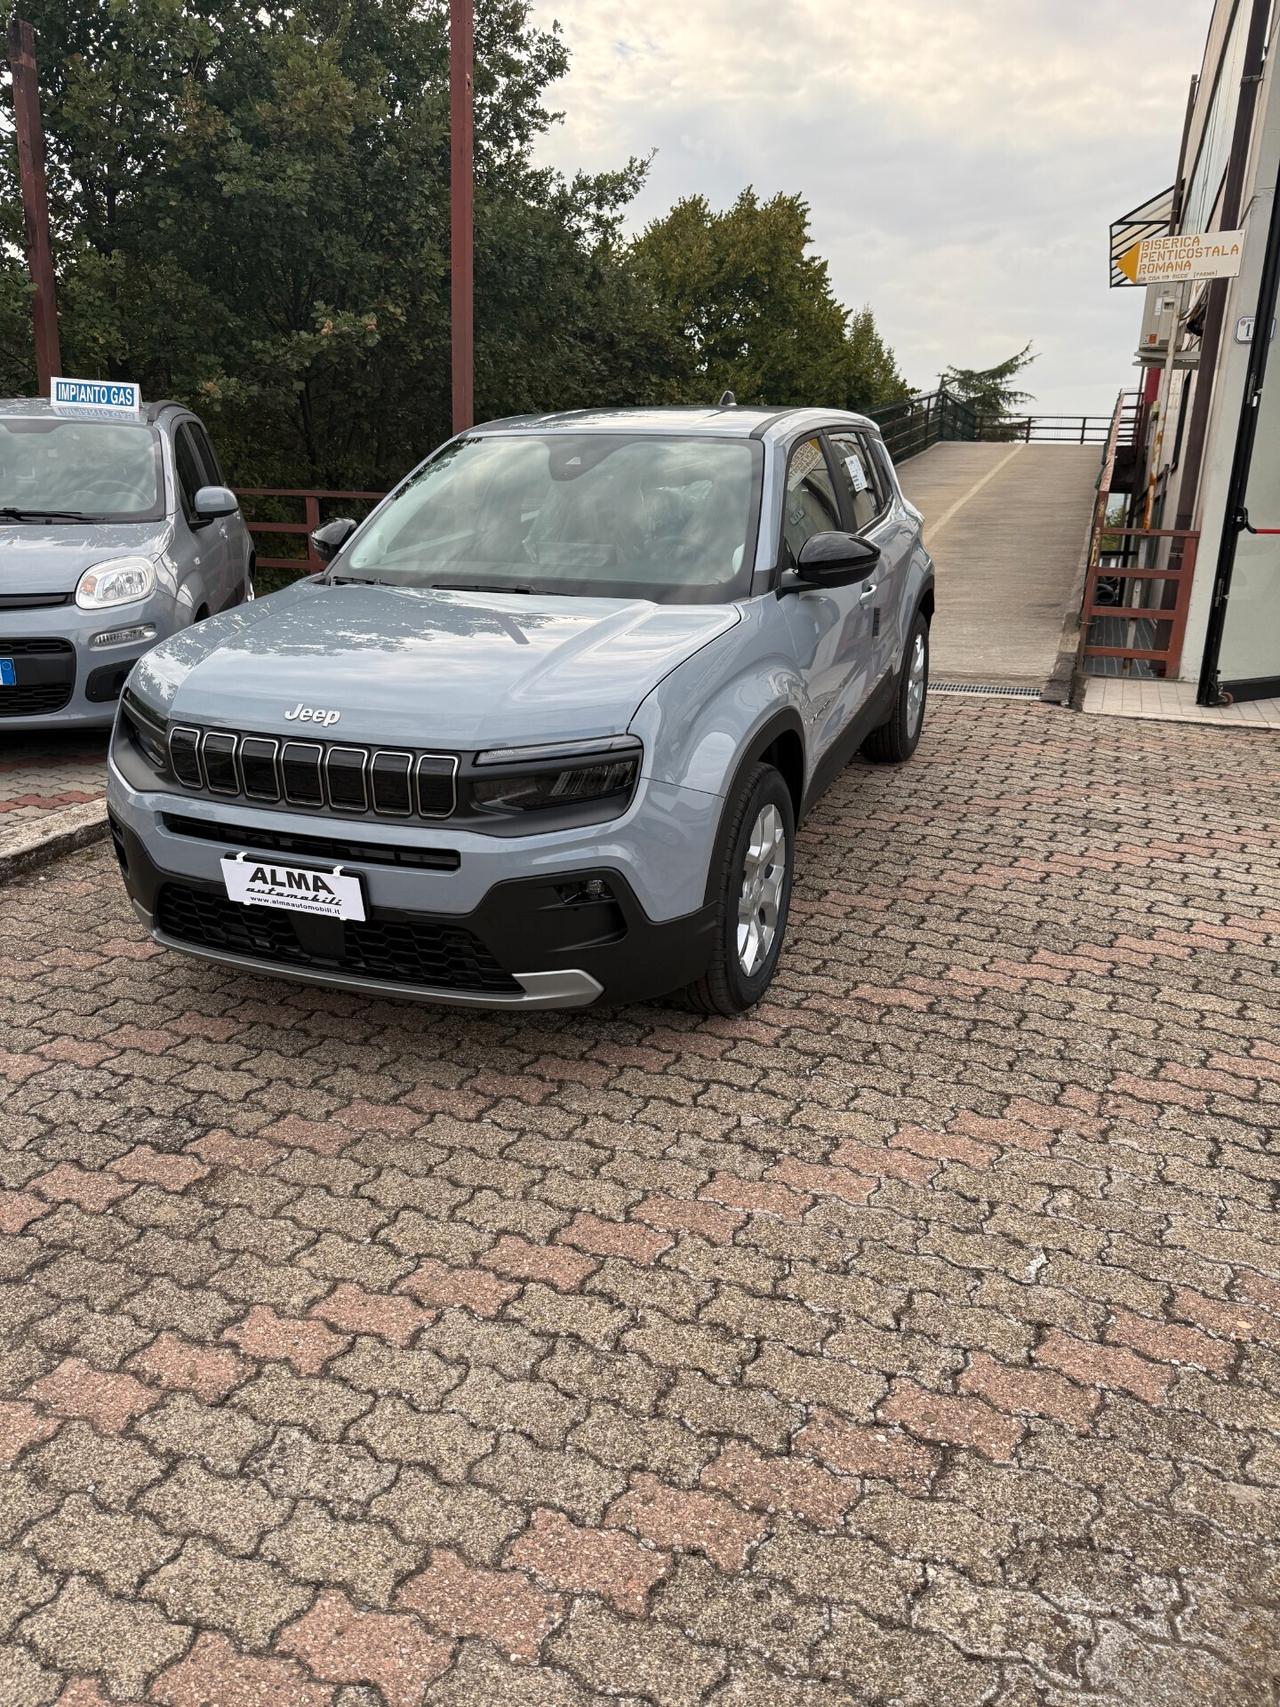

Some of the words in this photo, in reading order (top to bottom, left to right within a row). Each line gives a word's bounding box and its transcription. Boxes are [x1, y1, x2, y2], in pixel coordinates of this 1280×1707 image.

[1140, 244, 1239, 262] PENTICOSTALA
[1142, 236, 1200, 251] BISERICA
[1139, 260, 1192, 275] ROMANA
[58, 383, 108, 403] IMPIANTO
[110, 387, 133, 405] GAS
[284, 703, 341, 727] Jeep
[249, 867, 335, 895] ALMA
[250, 896, 341, 915] www.almaautomobili.it
